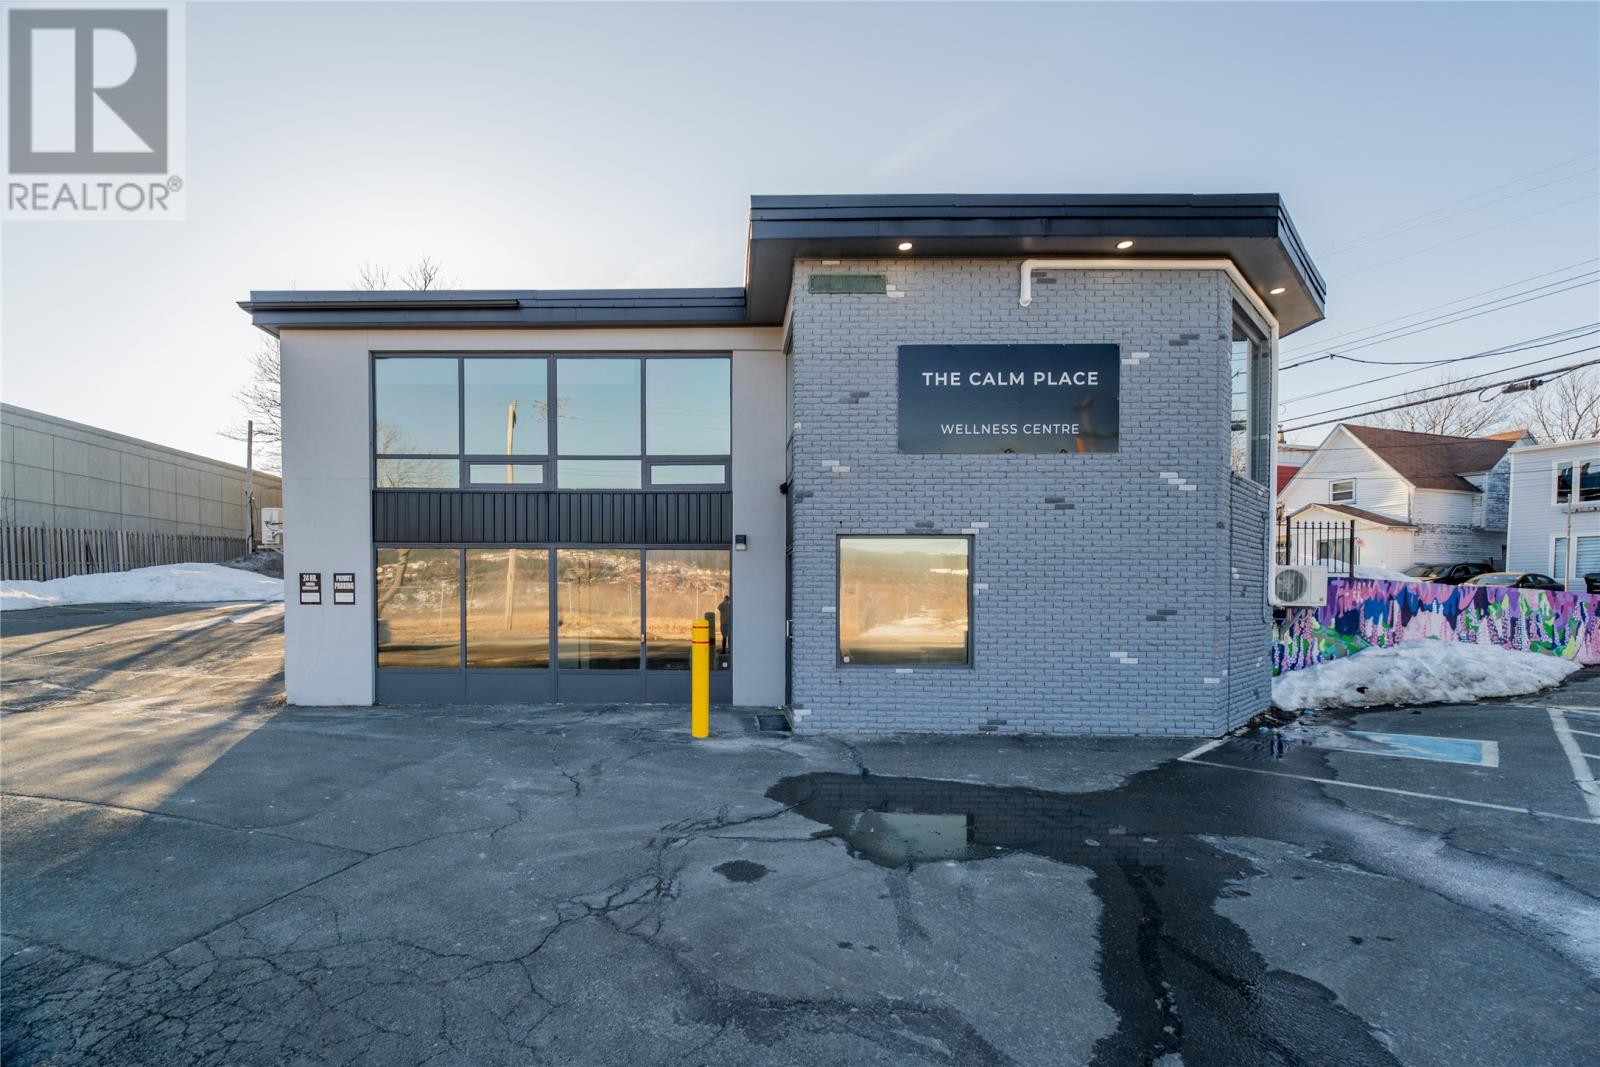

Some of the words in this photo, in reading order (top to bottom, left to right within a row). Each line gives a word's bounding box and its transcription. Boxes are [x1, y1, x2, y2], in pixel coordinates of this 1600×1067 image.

[922, 372, 961, 386] THE
[969, 372, 1025, 386] CALM
[1033, 371, 1099, 386] PLACE
[941, 423, 1018, 435] WELLNESS
[1022, 423, 1079, 435] CENTRE
